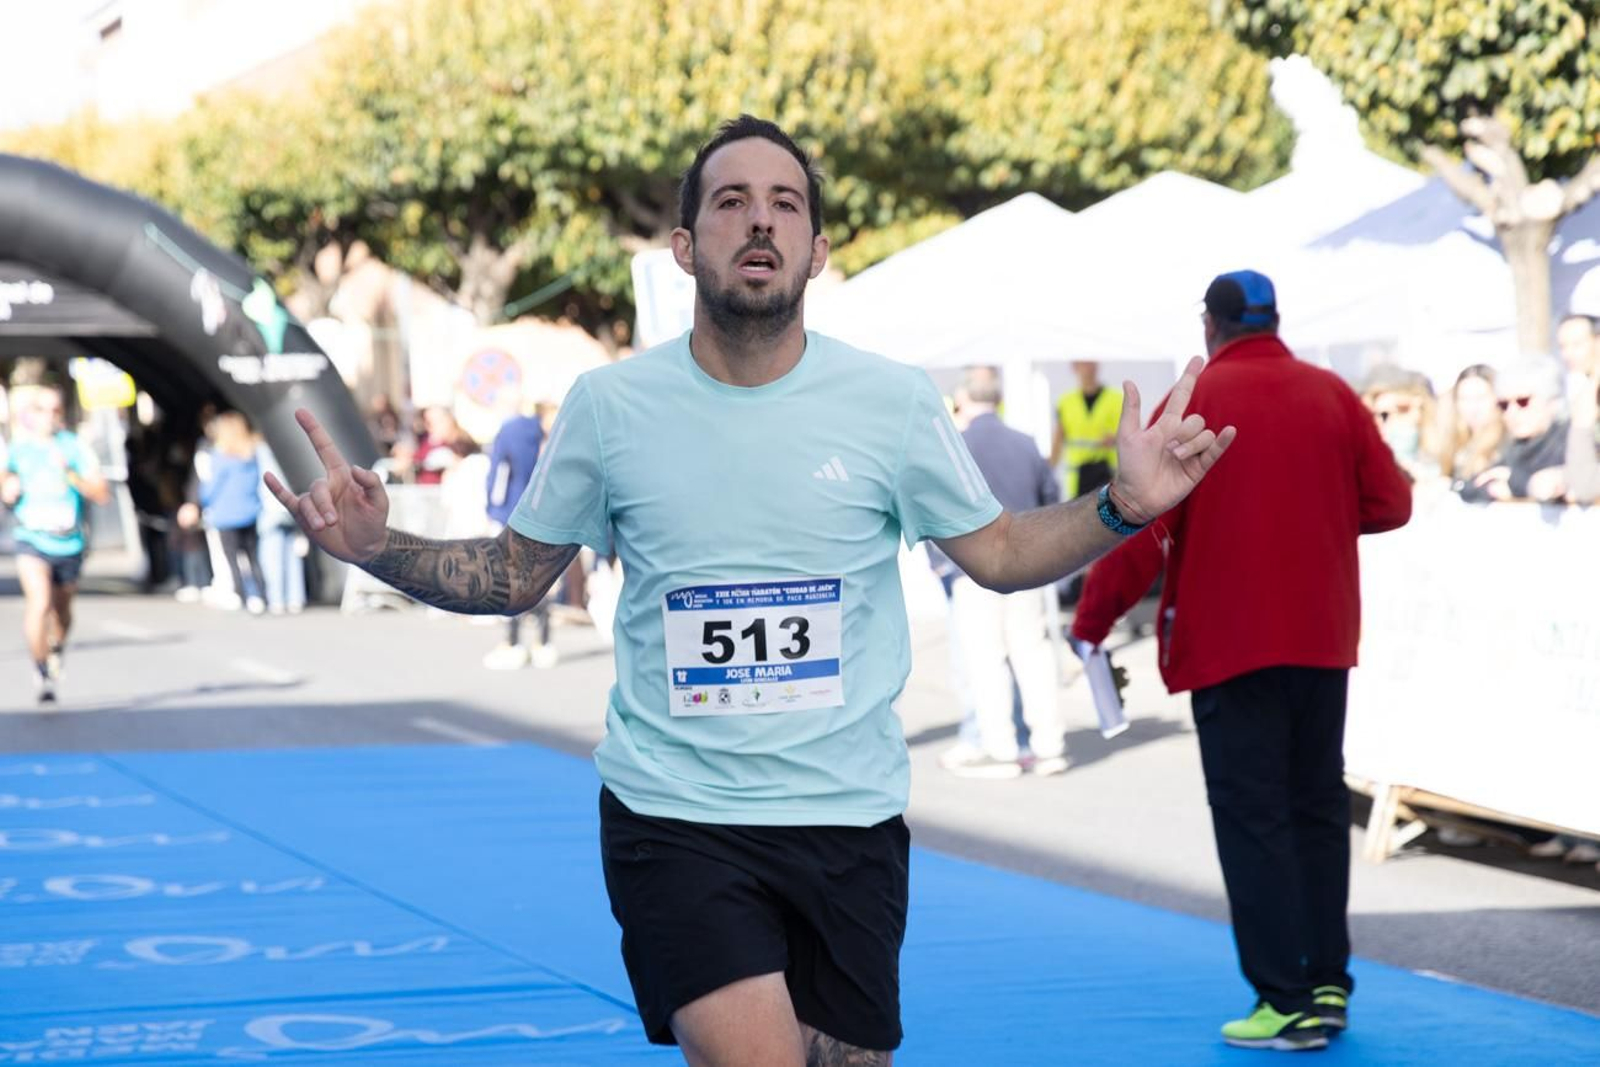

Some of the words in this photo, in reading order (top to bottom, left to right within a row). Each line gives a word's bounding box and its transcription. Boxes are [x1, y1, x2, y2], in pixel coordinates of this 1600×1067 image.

[808, 584, 817, 593] DE
[701, 616, 811, 665] 513
[725, 667, 751, 680] JOSE
[754, 665, 793, 679] MARIA
